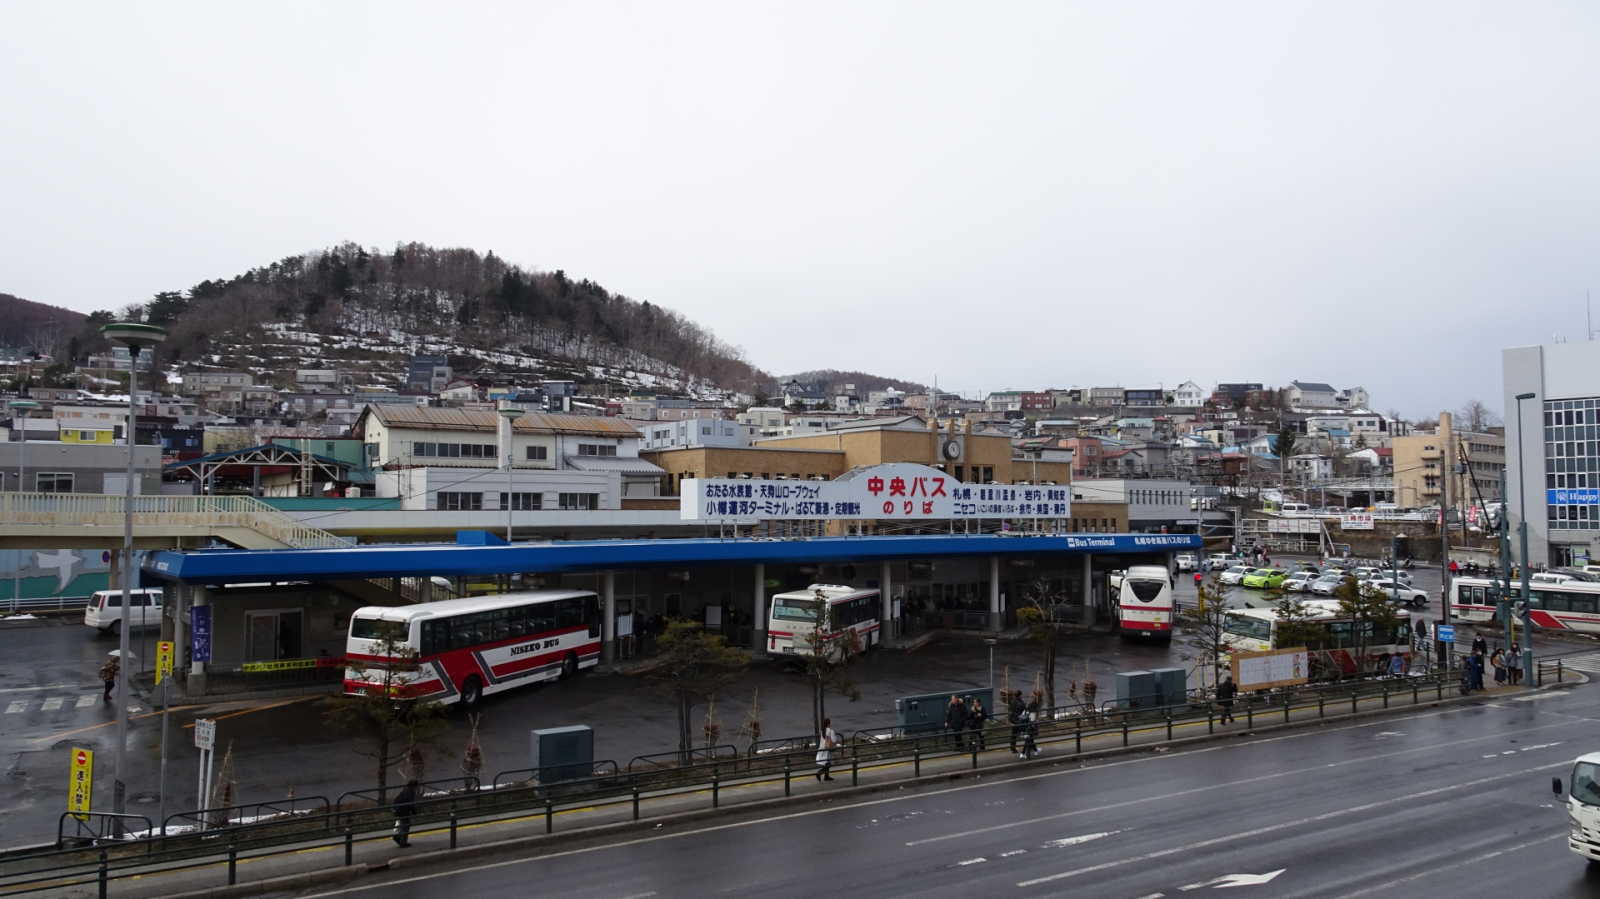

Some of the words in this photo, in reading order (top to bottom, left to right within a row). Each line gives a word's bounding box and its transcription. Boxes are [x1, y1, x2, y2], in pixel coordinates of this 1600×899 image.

[867, 475, 947, 497] 中央バス
[1569, 492, 1599, 502] Happy
[883, 500, 934, 515] のりば
[1075, 538, 1087, 547] Bus
[1088, 537, 1115, 546] Terminal
[510, 642, 541, 657] NISEKO
[543, 638, 560, 649] BUS
